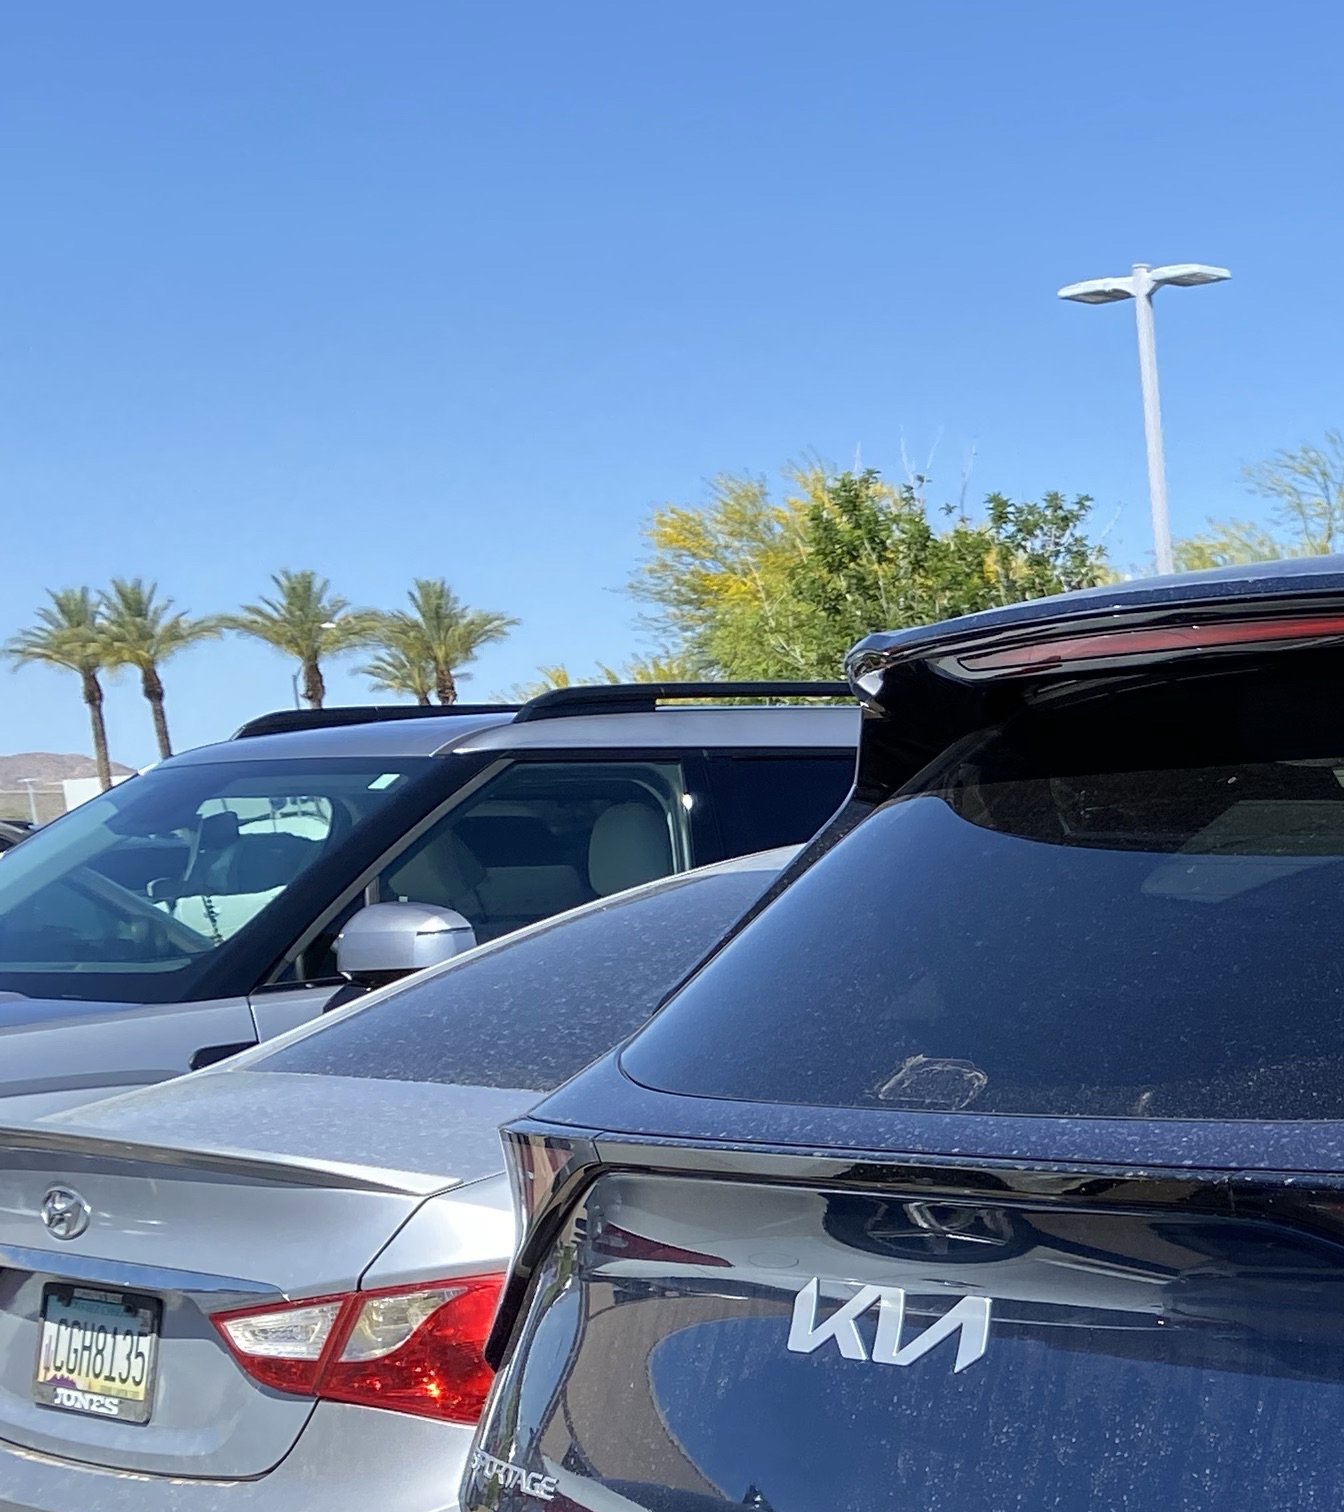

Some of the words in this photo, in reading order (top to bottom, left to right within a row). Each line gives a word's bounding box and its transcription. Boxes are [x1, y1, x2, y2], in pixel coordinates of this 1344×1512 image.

[53, 1318, 148, 1387] CGH8135
[787, 1276, 993, 1374] KIA
[54, 1387, 119, 1415] JONES
